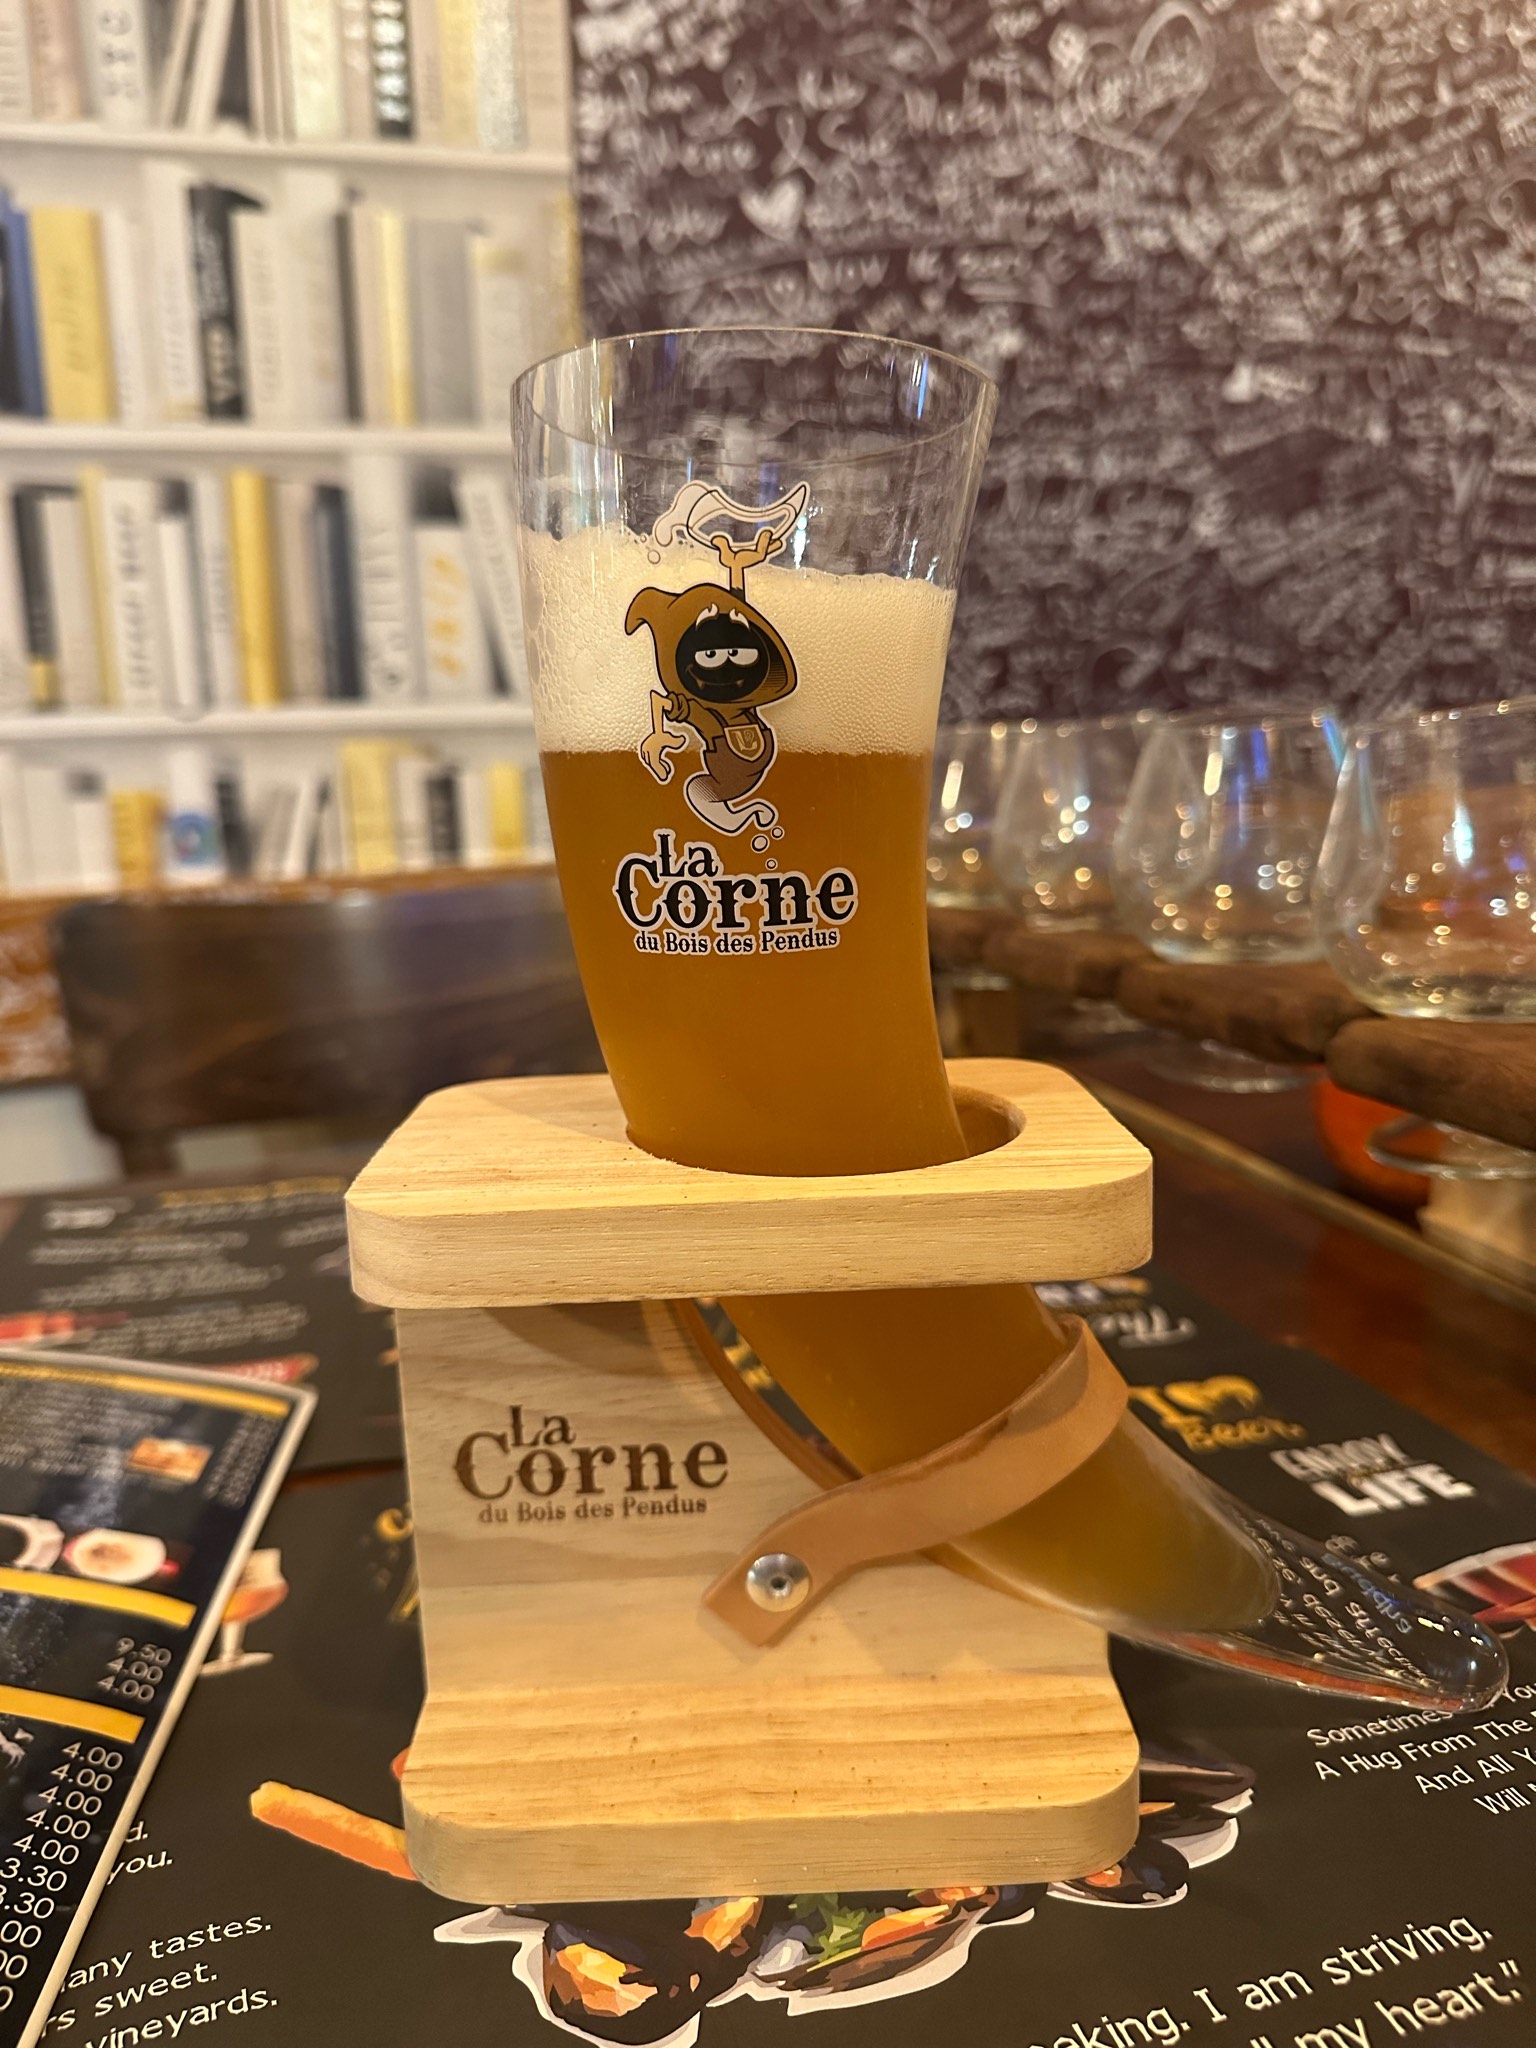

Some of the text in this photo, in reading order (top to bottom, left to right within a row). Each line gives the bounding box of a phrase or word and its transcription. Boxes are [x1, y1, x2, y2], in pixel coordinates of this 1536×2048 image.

[656, 832, 721, 879] La
[614, 855, 857, 931] Corne
[636, 929, 838, 953] du Bois des Pendus
[509, 1404, 576, 1447] La
[453, 1430, 728, 1500] Corne
[1311, 1463, 1477, 1516] LIFE
[479, 1495, 708, 1524] du Bois des Pendus
[97, 1675, 155, 1703] 4.00
[106, 1656, 164, 1686] 4.00
[62, 1742, 123, 1770] 4.00
[1315, 1718, 1533, 1780] A Hug From The
[51, 1764, 113, 1792] 4.00
[1415, 1764, 1475, 1794] And
[1477, 1754, 1515, 1779] All
[38, 1786, 102, 1815] 4.00
[1473, 1786, 1531, 1815] Will
[26, 1809, 91, 1840] 4.00
[13, 1834, 80, 1865] 4.00
[0, 1857, 68, 1892] 3.30
[150, 1916, 272, 1958] tastes.
[1193, 1988, 1228, 2023] I
[1237, 1970, 1314, 2011] am
[1321, 1917, 1494, 1986] striving.
[94, 1962, 218, 2018] sweet.
[85, 1988, 278, 2048] vineyards.
